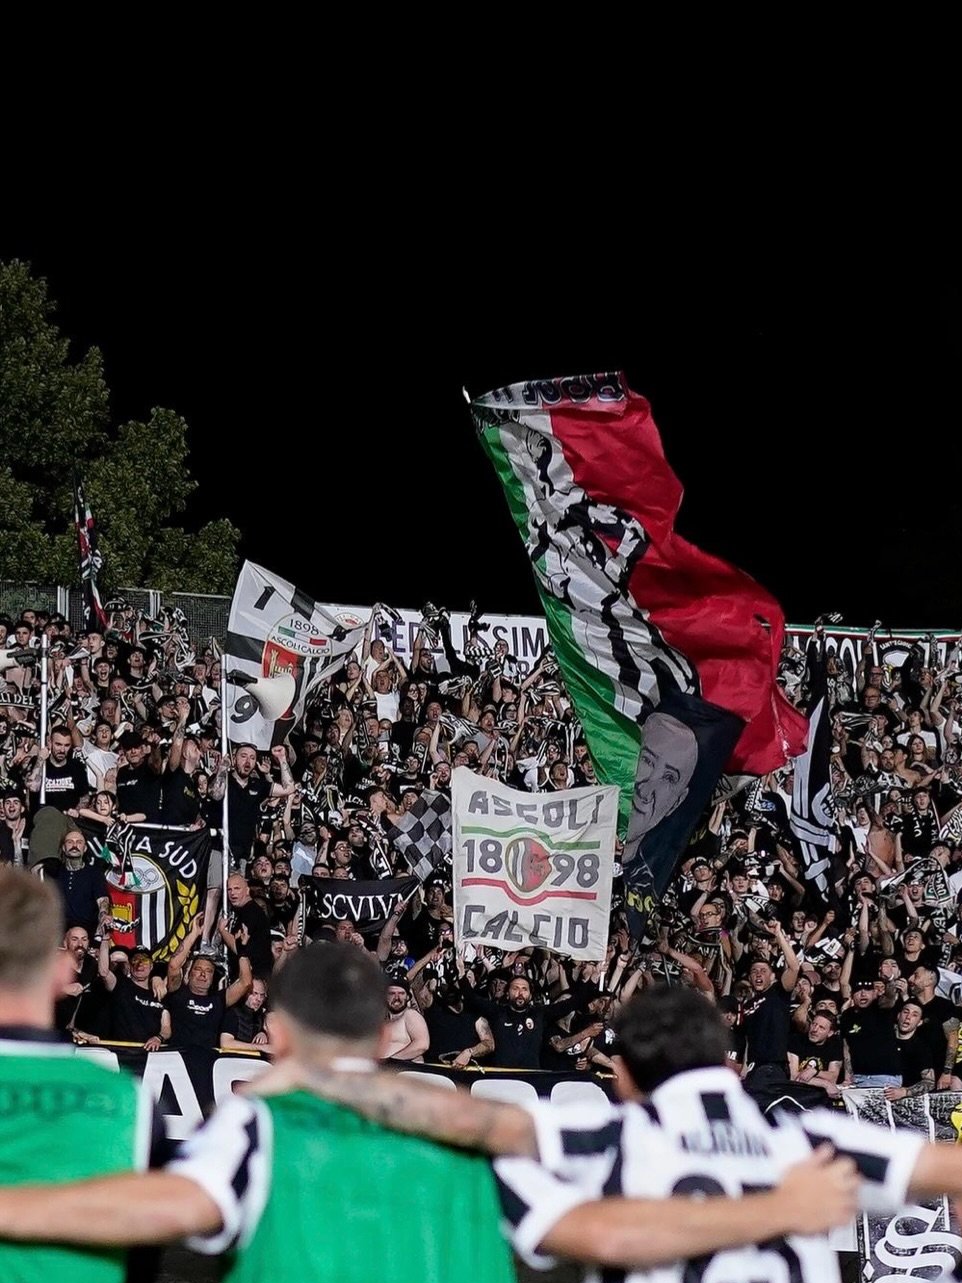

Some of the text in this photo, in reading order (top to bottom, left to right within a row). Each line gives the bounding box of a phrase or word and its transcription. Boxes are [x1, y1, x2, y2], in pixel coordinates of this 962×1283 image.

[289, 618, 319, 636] 1898
[271, 636, 330, 655] ASCOLI CALCIO
[230, 694, 259, 724] 9
[467, 790, 605, 830] ASCOLI
[158, 841, 198, 879] SUD
[462, 838, 600, 888] 18 98
[308, 892, 406, 922] SCVLV
[462, 904, 590, 949] CALCIO
